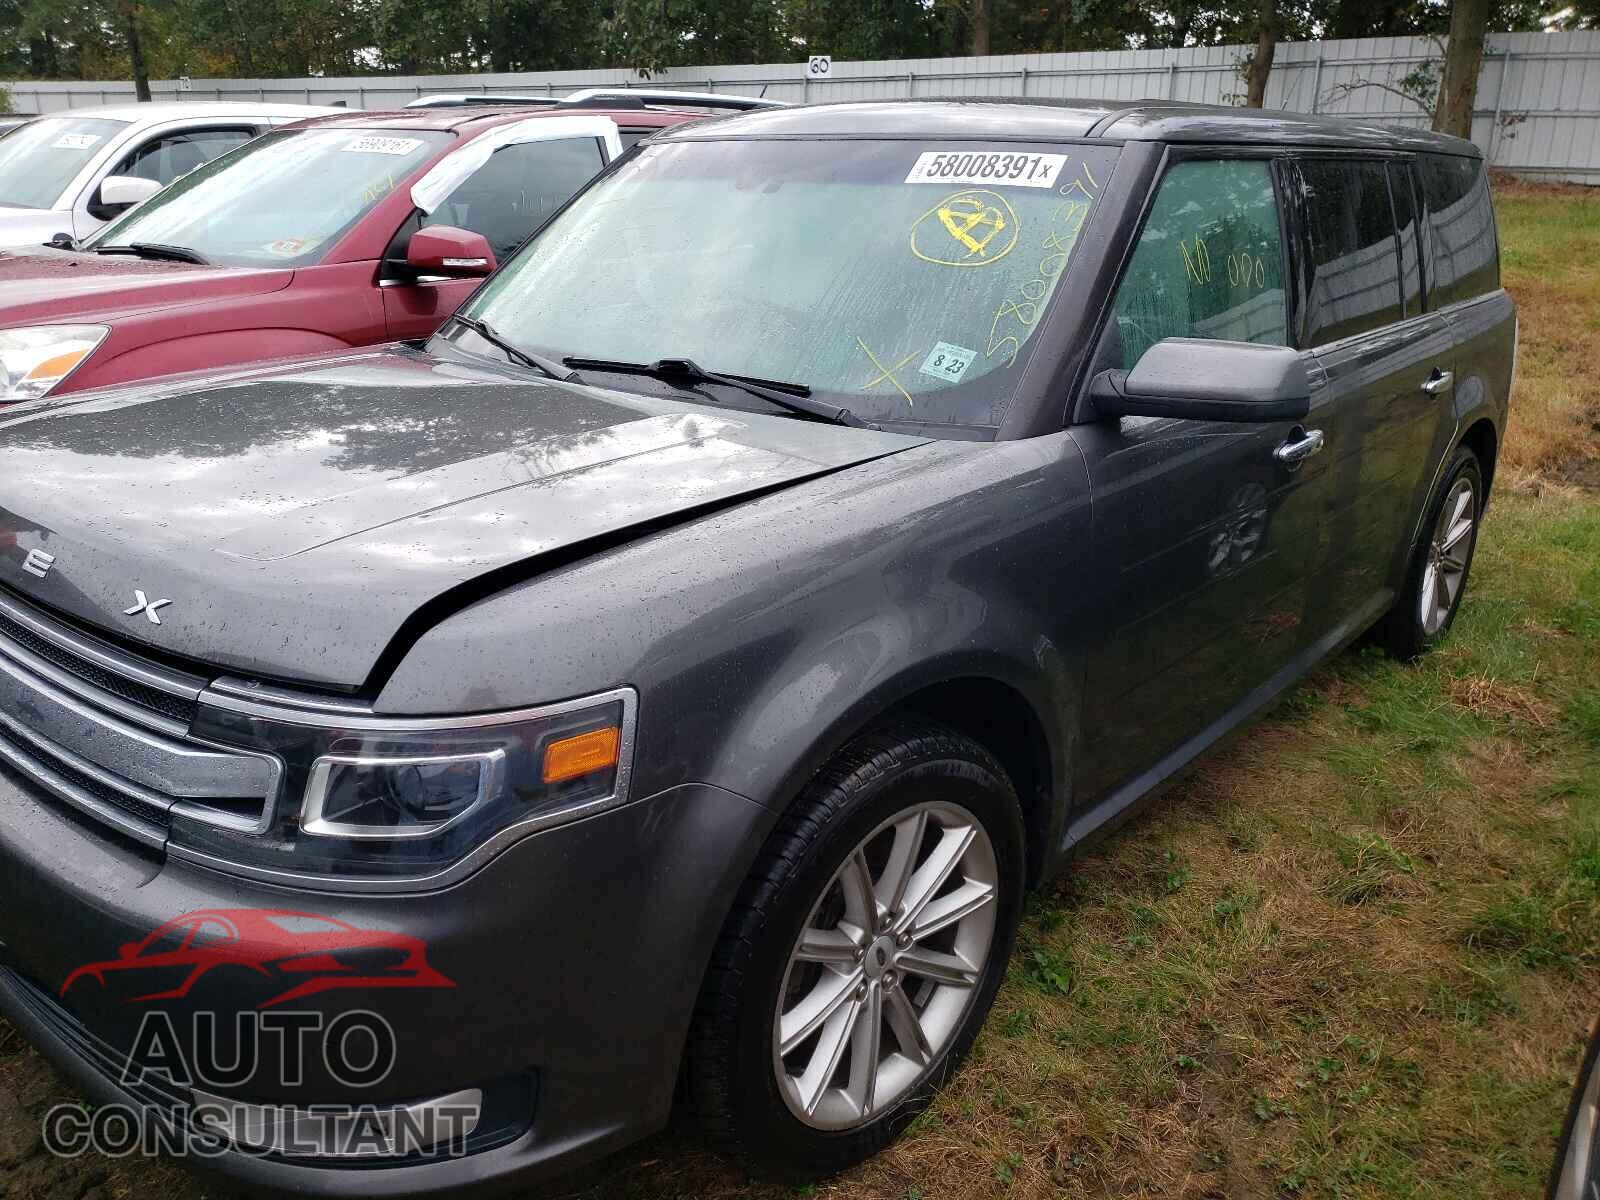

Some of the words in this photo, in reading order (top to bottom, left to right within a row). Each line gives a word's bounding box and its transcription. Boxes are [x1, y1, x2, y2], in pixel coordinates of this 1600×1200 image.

[810, 57, 829, 74] 60
[934, 354, 946, 367] 8
[945, 359, 965, 374] 23
